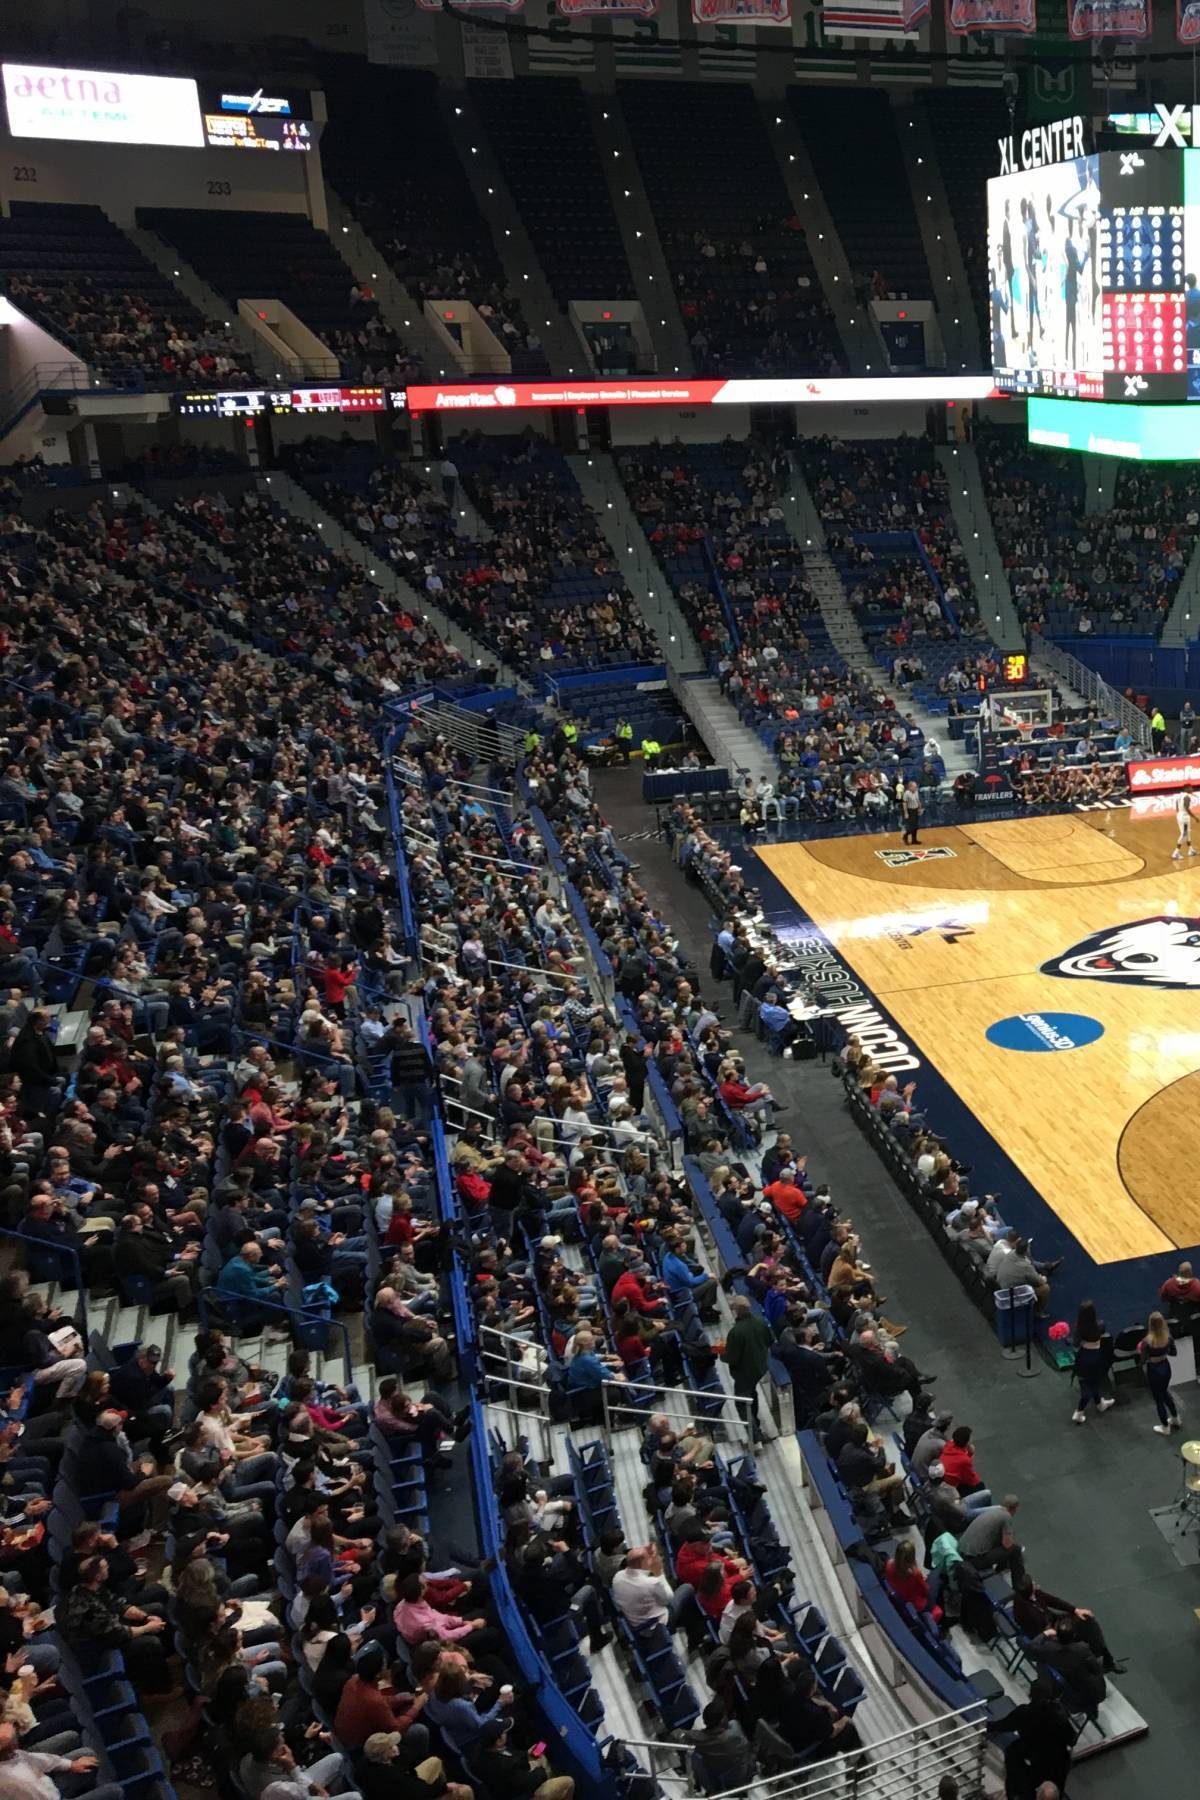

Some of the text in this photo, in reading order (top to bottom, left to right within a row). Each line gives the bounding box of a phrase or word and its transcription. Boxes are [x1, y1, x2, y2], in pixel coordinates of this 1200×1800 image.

[14, 75, 121, 104] aetna
[998, 115, 1086, 176] XL CENTER
[13, 166, 38, 182] 232
[207, 180, 232, 196] 233
[1115, 216, 1182, 229] 0 0 0 0
[1134, 230, 1182, 243] 1 1 0
[1132, 245, 1142, 257] 0
[1152, 245, 1162, 257] 0
[1172, 245, 1182, 257] 0
[1117, 259, 1182, 272] 4 2 2 0
[1134, 273, 1141, 285] 1
[1152, 273, 1162, 285] 0
[1174, 273, 1181, 285] 1
[435, 392, 496, 407] Ameritas
[1007, 664, 1024, 680] 30
[1152, 767, 1184, 783] State
[974, 791, 1014, 801] TRAVELERS
[837, 1004, 920, 1073] UCONN
